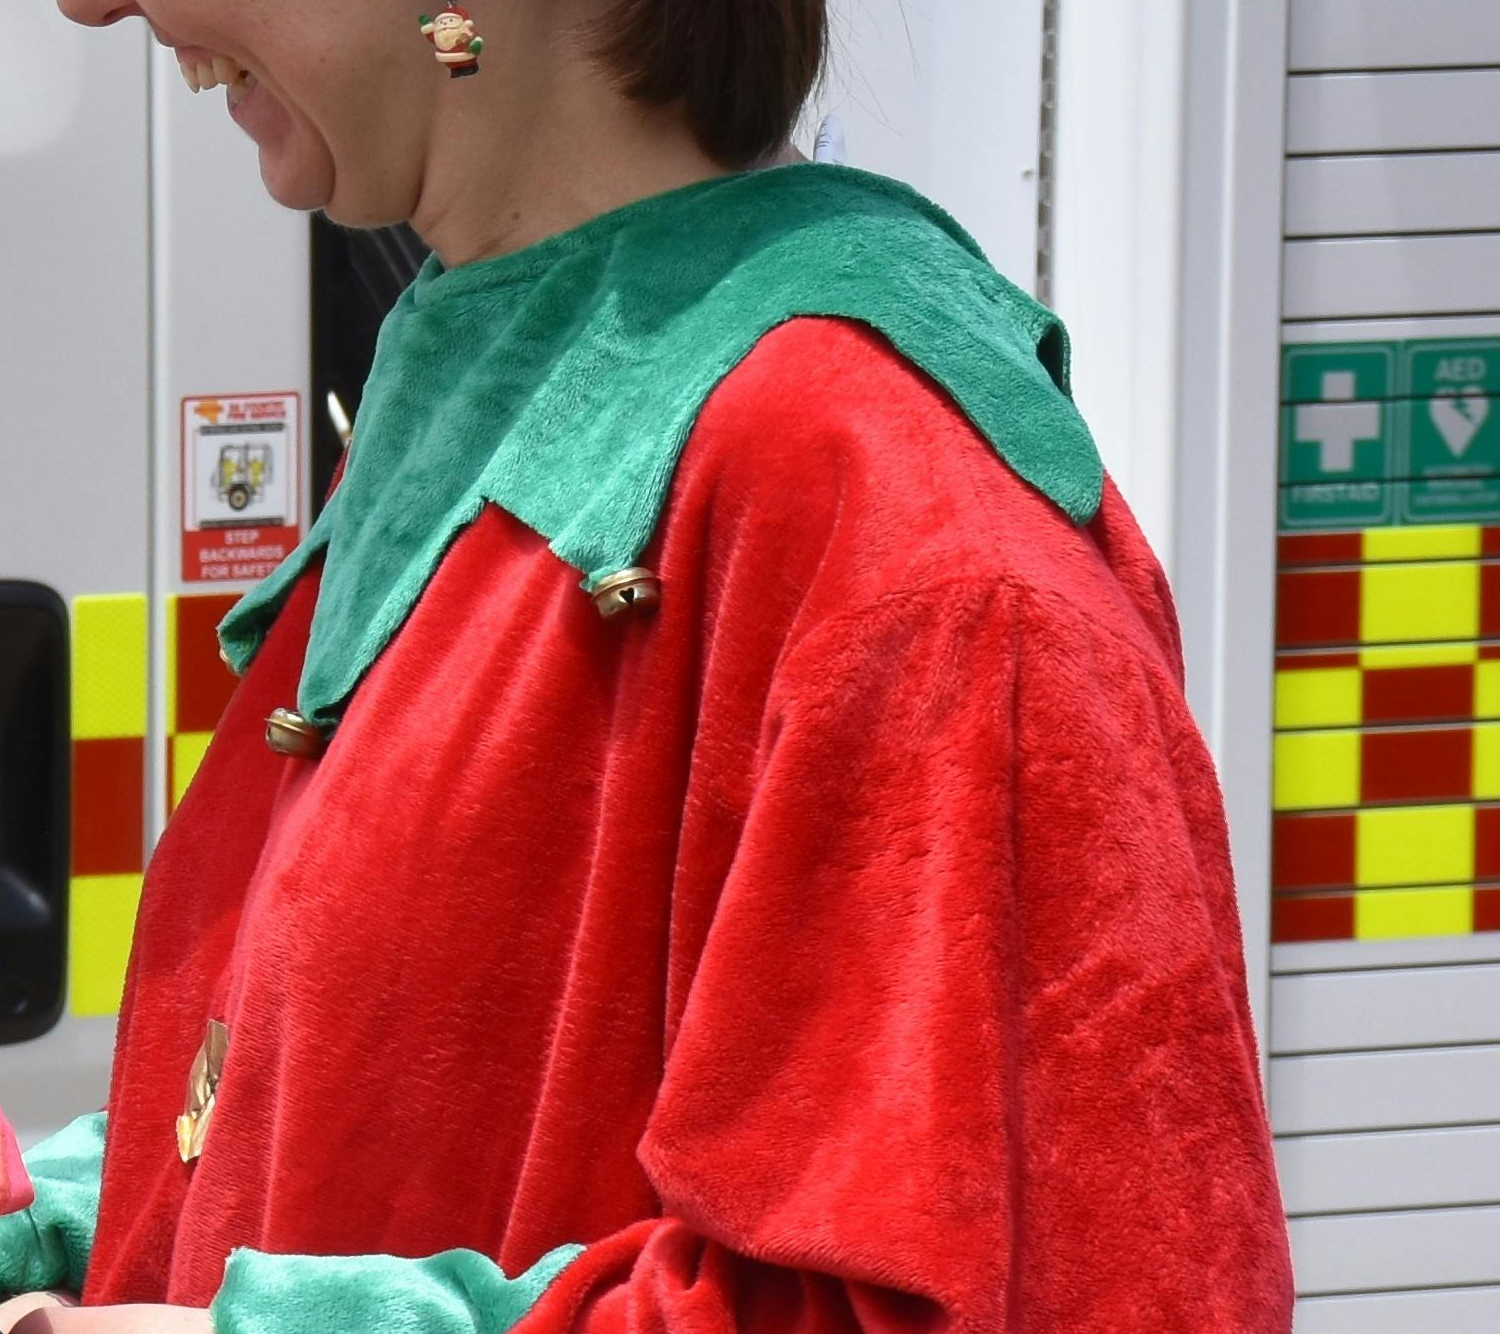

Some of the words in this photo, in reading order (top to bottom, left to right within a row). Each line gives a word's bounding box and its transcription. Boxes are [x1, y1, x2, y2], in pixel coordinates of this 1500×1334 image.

[1435, 357, 1487, 382] AED
[224, 529, 259, 545] STEP
[198, 545, 285, 563] BACKWARDS
[200, 564, 230, 580] FOR
